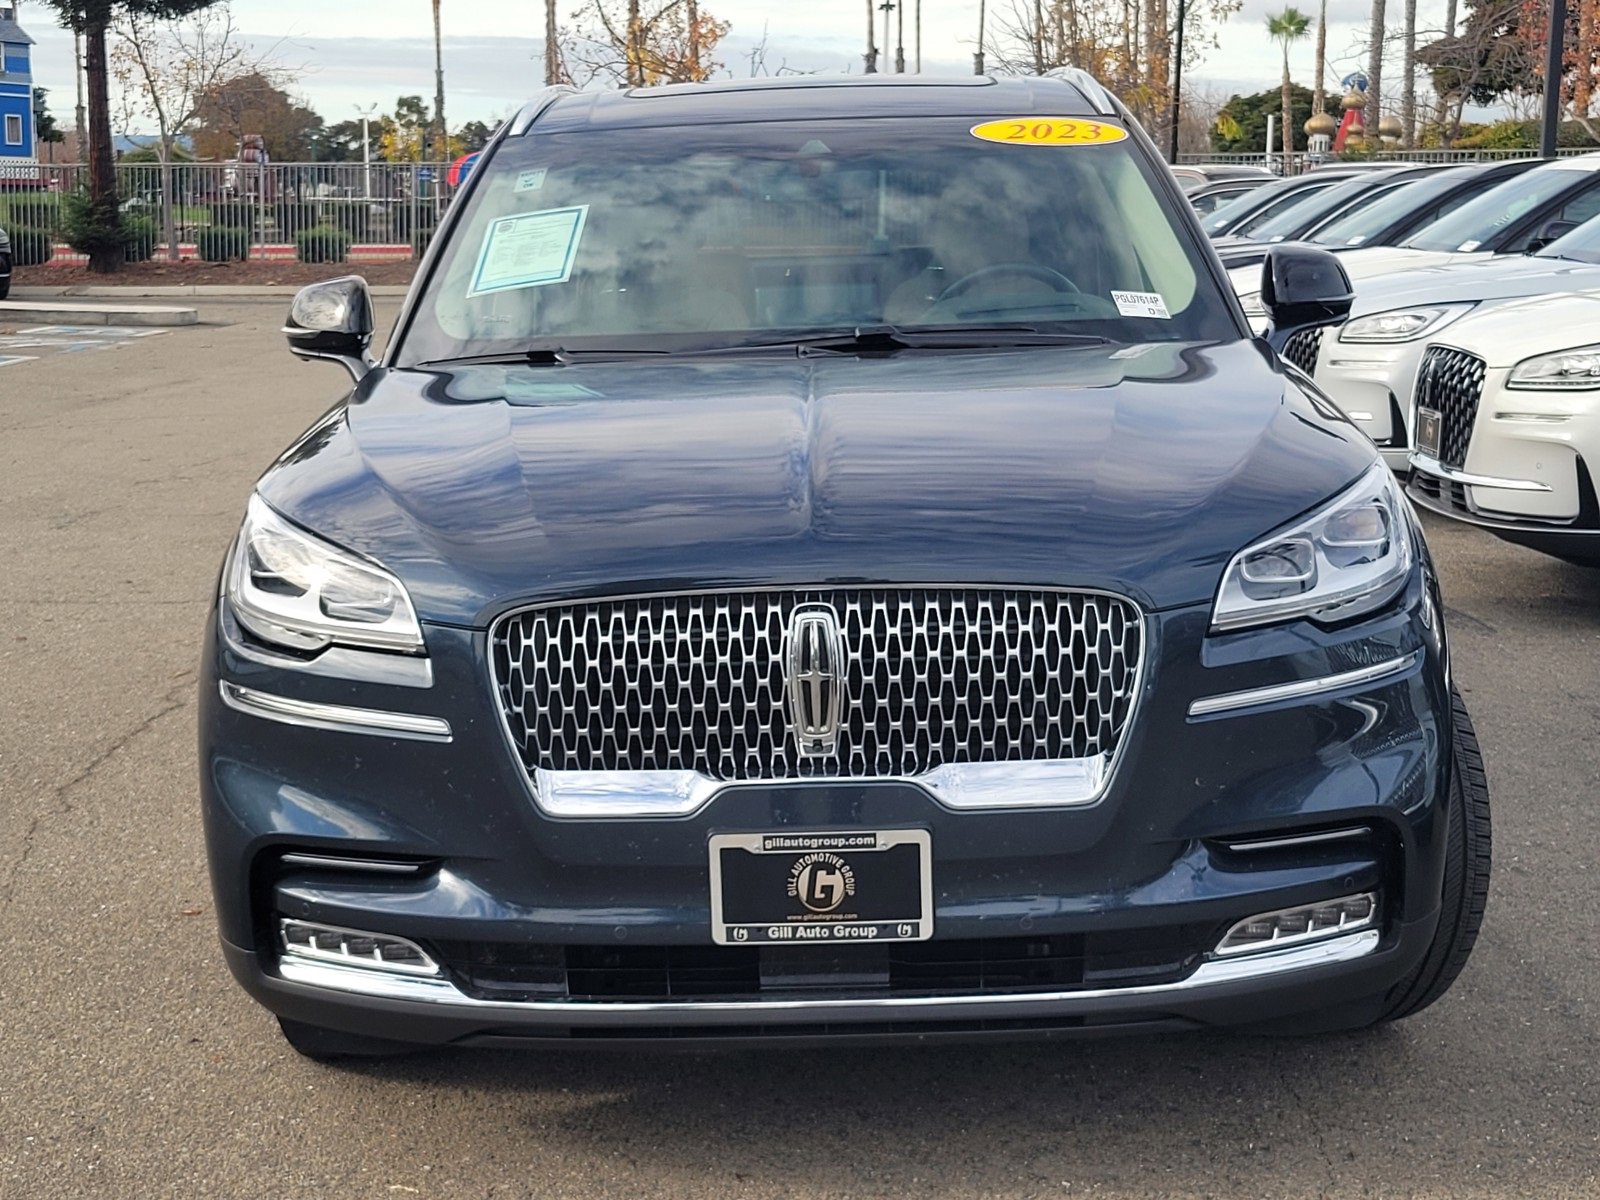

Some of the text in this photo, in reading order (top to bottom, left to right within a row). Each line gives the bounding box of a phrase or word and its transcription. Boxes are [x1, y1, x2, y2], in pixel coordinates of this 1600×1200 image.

[1006, 124, 1102, 140] 2023
[764, 836, 875, 849] gillautogroup.com
[787, 852, 855, 897] GILL AUTOMOTIVE GROUP
[768, 924, 878, 939] Gill Auto Group
